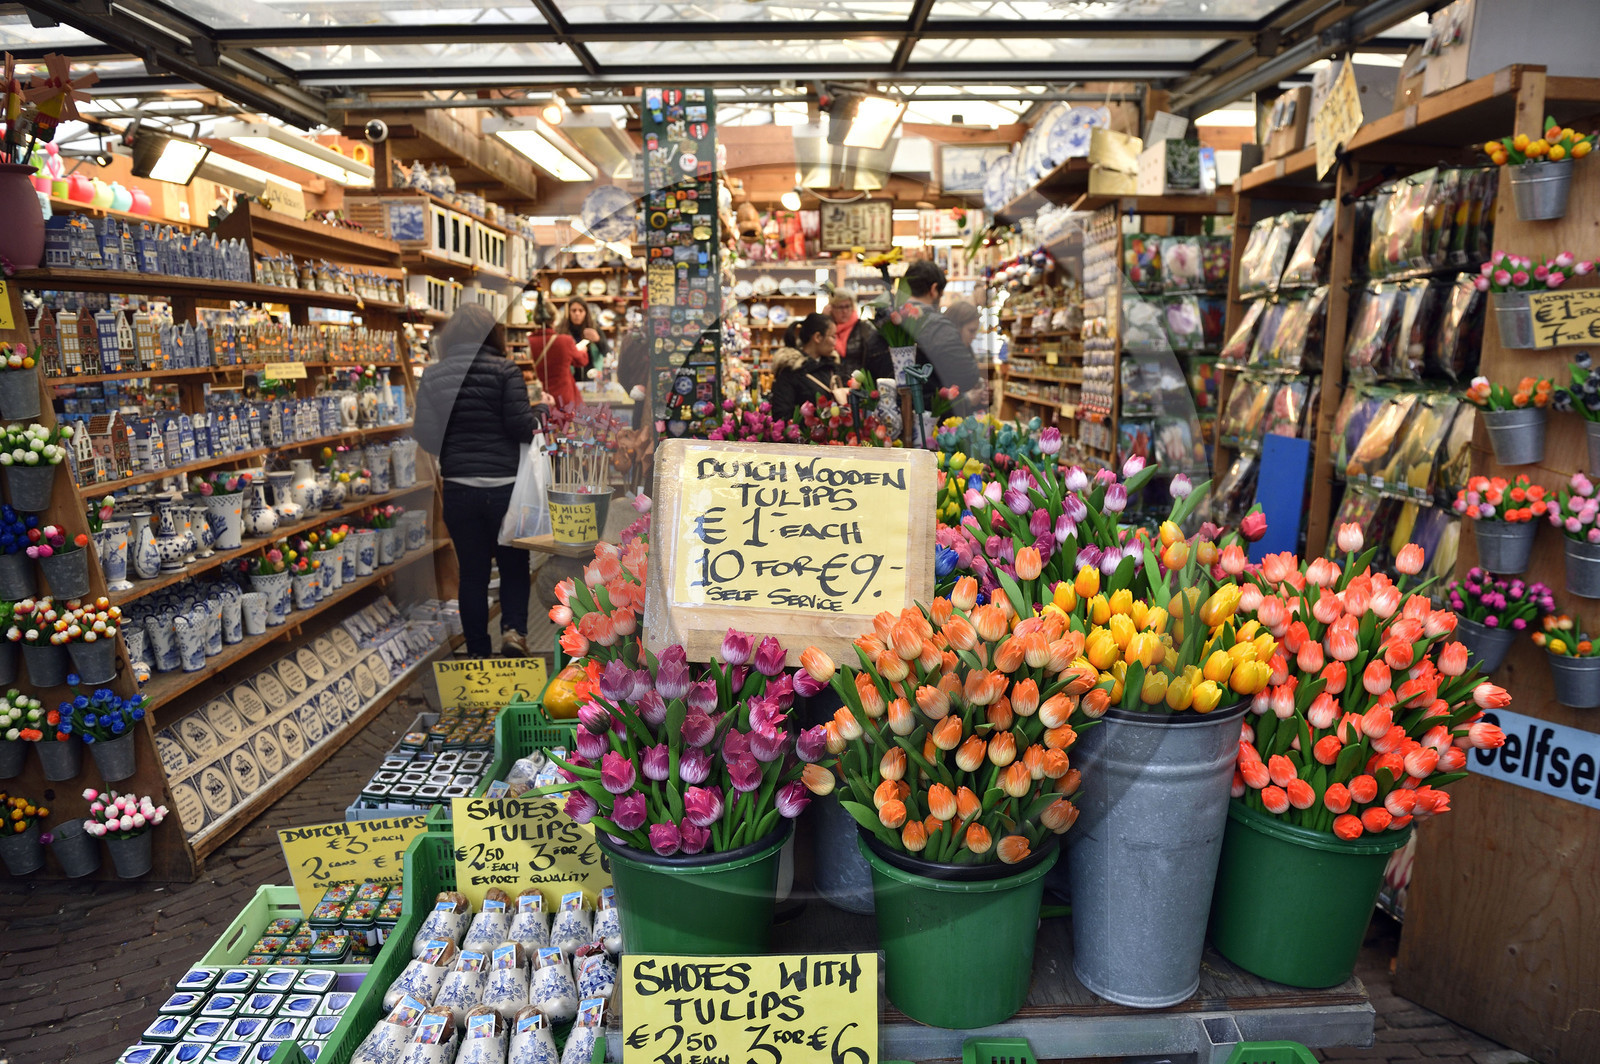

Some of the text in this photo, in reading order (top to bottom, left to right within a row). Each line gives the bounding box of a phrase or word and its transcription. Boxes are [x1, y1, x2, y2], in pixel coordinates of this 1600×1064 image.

[1541, 323, 1568, 346] 7
[697, 457, 907, 490] DUTCH WOODEN
[730, 483, 858, 511] TULIPS
[562, 506, 591, 514] MILLS
[778, 522, 863, 544] EACH
[690, 548, 745, 587] 10
[751, 556, 824, 578] FOR
[706, 586, 843, 612] SELF SERVICE
[438, 659, 539, 673] DUTCH TULIPS
[452, 686, 467, 701] 2
[1475, 713, 1600, 799] Selfse
[467, 799, 559, 820] SHOES
[280, 816, 428, 843] DUTCH TULIPS
[372, 834, 404, 842] EACH
[482, 818, 582, 843] TULIPS
[302, 856, 330, 880] 2
[328, 860, 357, 868] CANS
[491, 861, 519, 872] EACH
[528, 843, 556, 871] 3
[553, 845, 578, 855] FOR
[471, 872, 589, 885] EXPORT QUALITY
[633, 954, 862, 996] SHOES WITH
[664, 990, 805, 1025] TULIPS
[744, 1024, 783, 1064] 3
[773, 1029, 805, 1044] FOR
